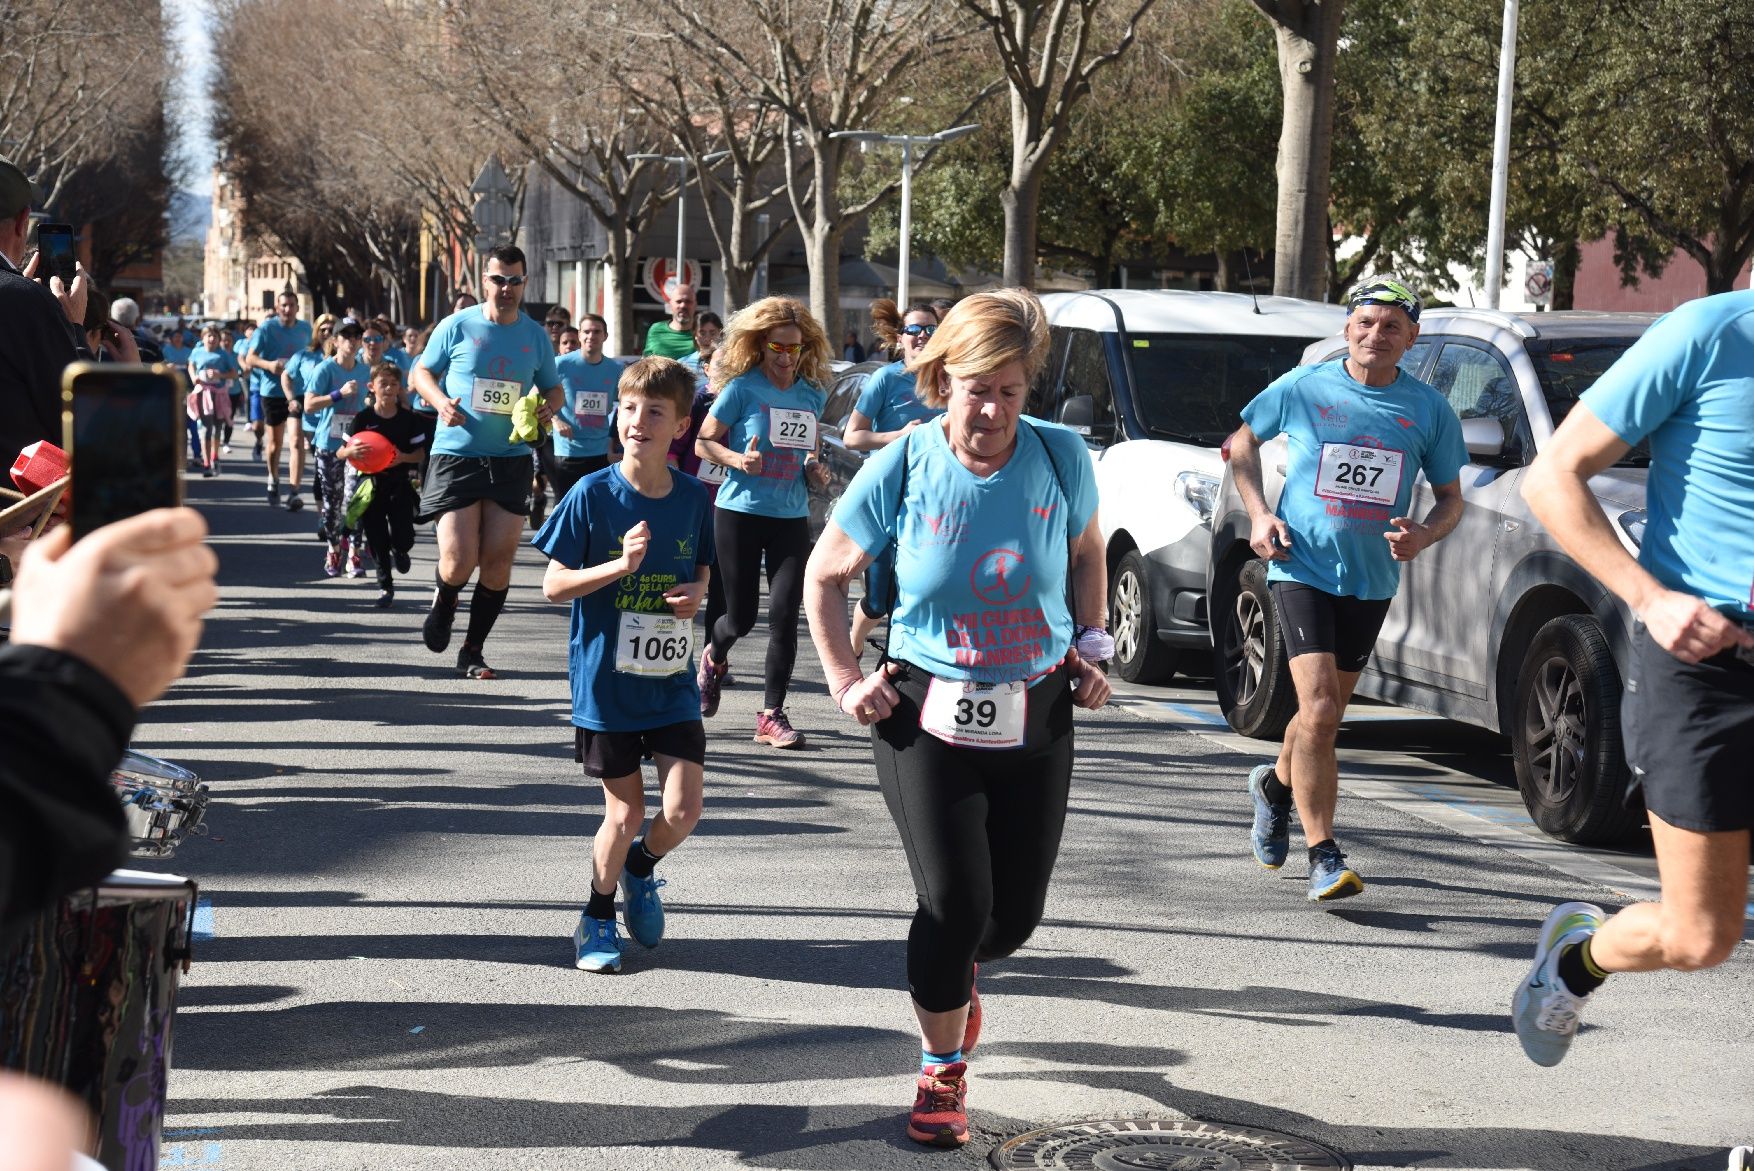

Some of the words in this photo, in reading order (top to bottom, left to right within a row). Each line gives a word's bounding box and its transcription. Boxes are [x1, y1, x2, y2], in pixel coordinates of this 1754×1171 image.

[482, 390, 510, 405] 593
[582, 398, 601, 410] 201
[780, 421, 808, 439] 272
[1335, 462, 1385, 488] 267
[640, 583, 650, 592] DE
[651, 583, 662, 592] LA
[981, 607, 1043, 627] CURSA
[947, 628, 972, 648] DE
[973, 629, 997, 648] LA
[1001, 623, 1051, 646] DONA
[629, 635, 688, 662] 1063
[955, 641, 1044, 668] MANRESA
[954, 698, 997, 728] 39
